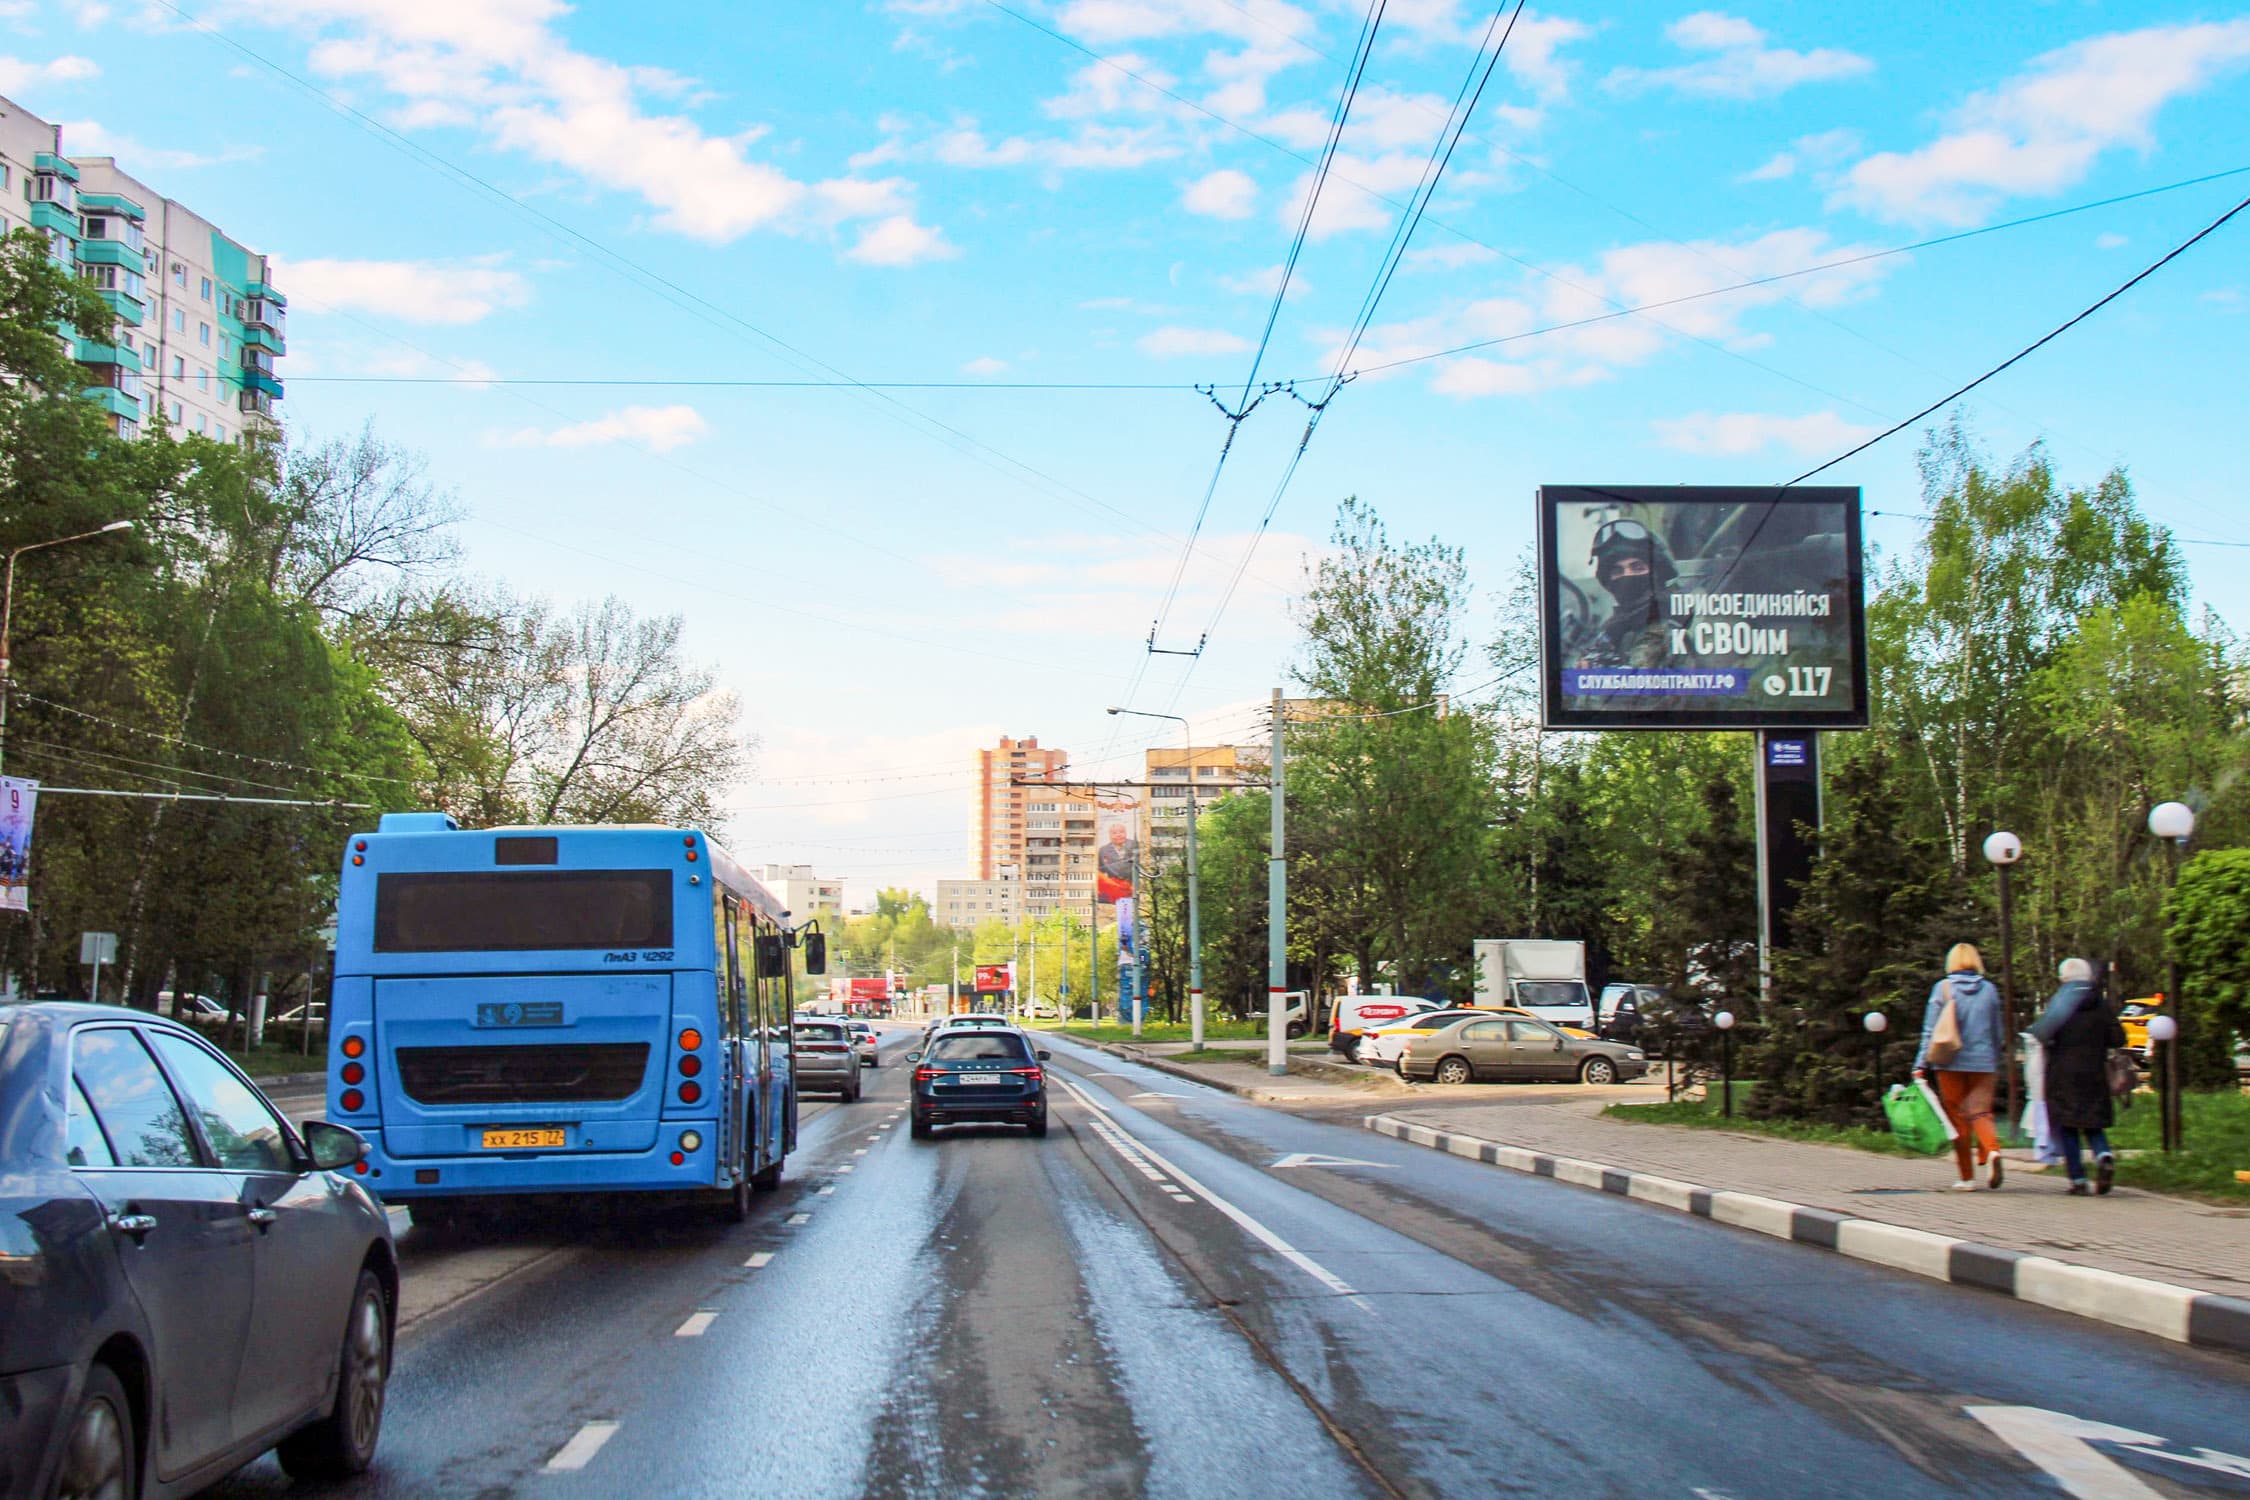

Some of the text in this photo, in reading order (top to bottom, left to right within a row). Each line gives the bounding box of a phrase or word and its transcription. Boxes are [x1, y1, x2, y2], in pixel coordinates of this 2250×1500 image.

[1670, 590, 1830, 618] ПРИСОЕДИНЯЙСЯ
[1578, 674, 1736, 690] СЛУЖБАПОКОНТРАКТУ.РФ
[1788, 667, 1832, 696] 117
[11, 789, 19, 808] 9
[642, 951, 675, 961] 4292
[512, 1131, 539, 1145] 215
